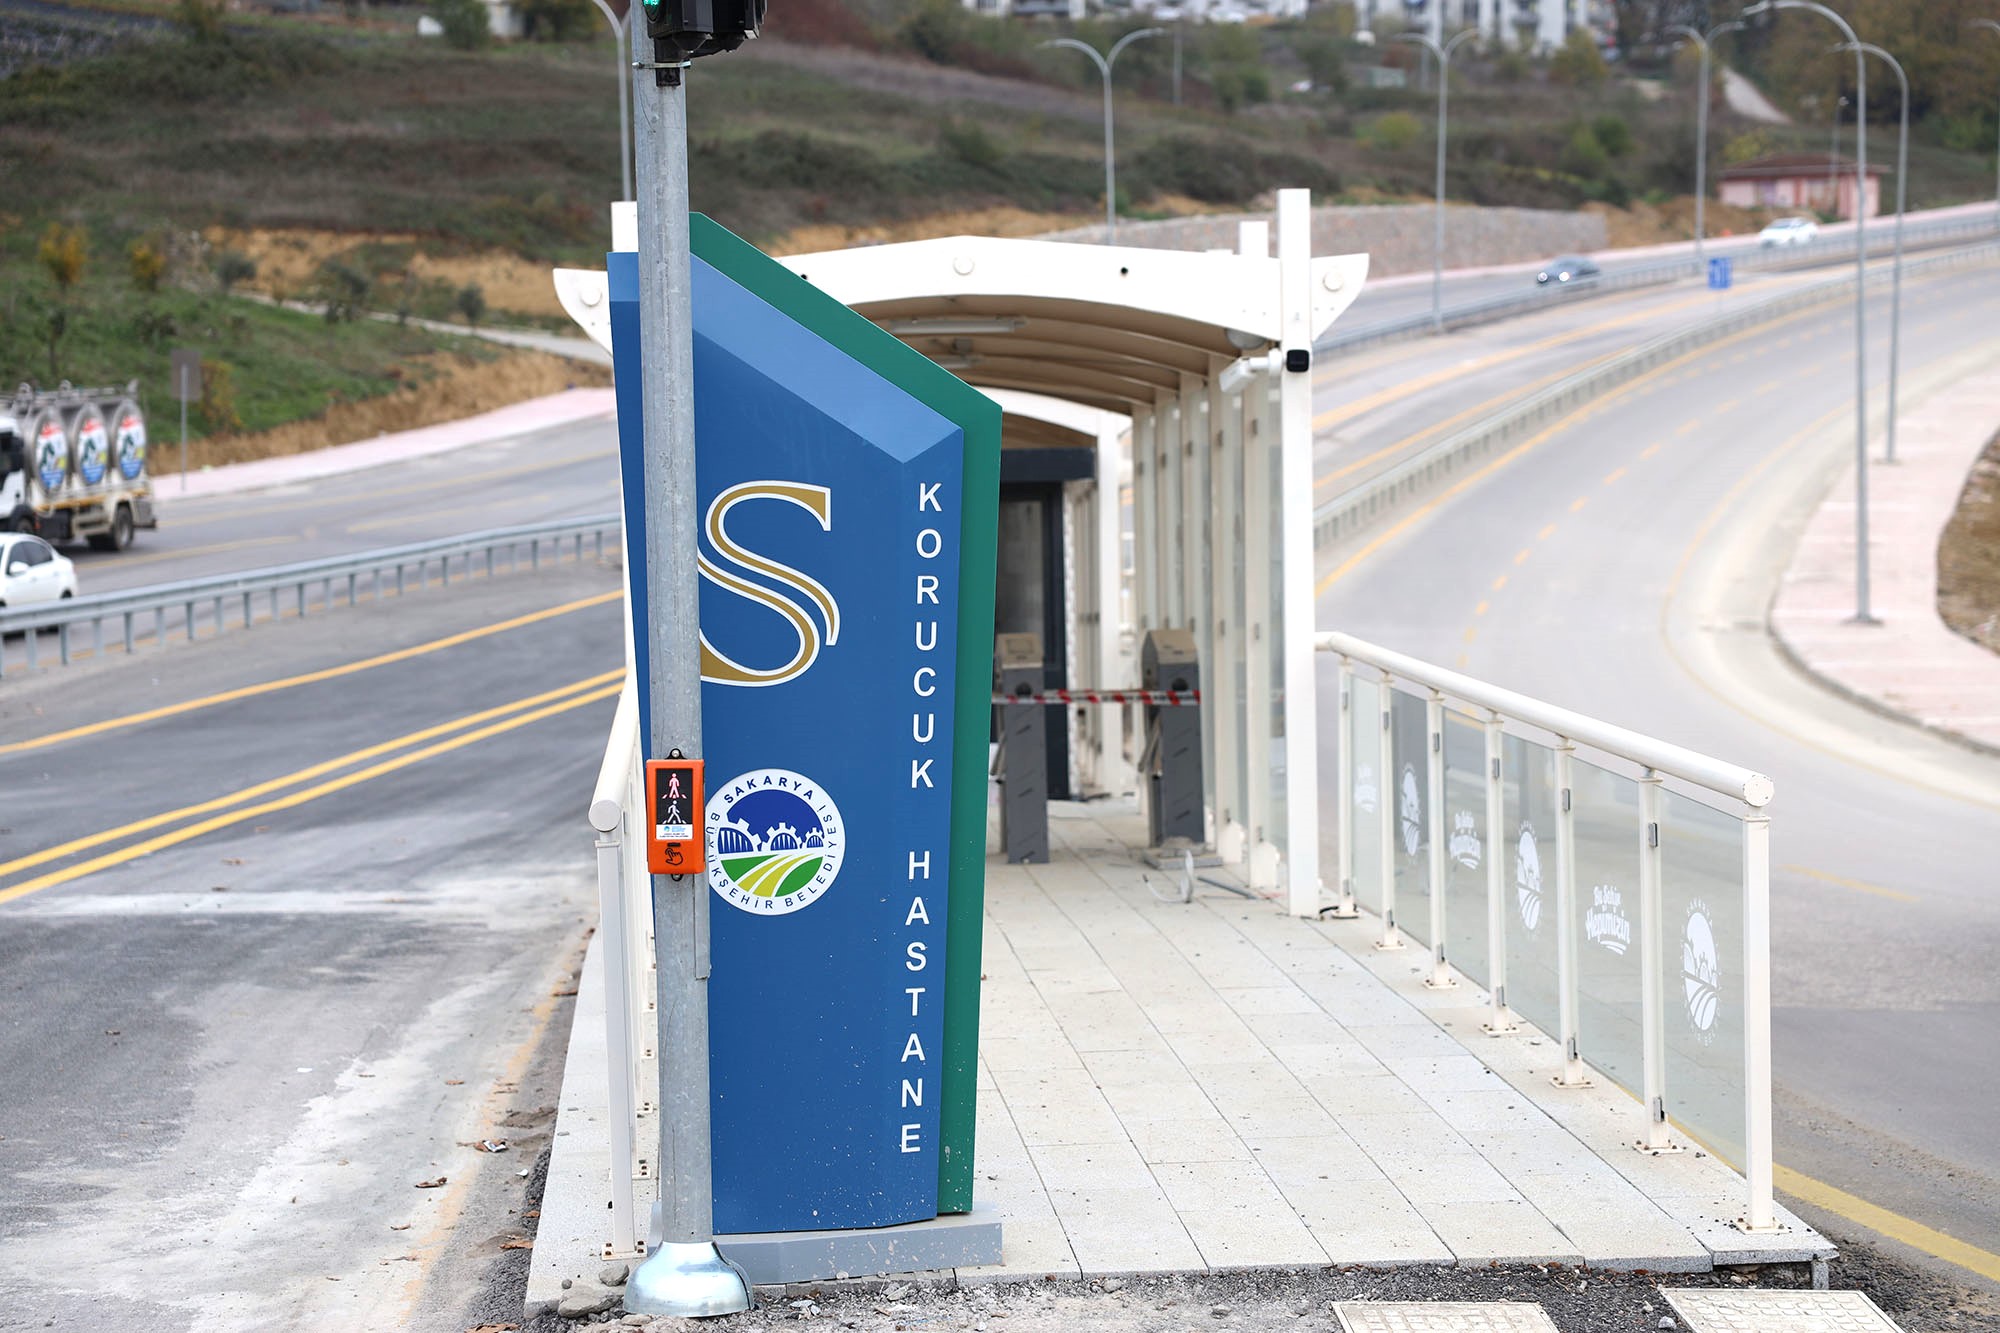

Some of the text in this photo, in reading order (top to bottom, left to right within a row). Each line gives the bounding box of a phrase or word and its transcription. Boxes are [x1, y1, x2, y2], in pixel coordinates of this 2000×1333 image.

[911, 482, 943, 789] KORUCUK
[724, 775, 814, 804] SAKARYA
[785, 804, 838, 908] BELEDİYESİ
[900, 850, 931, 1154] HASTANE
